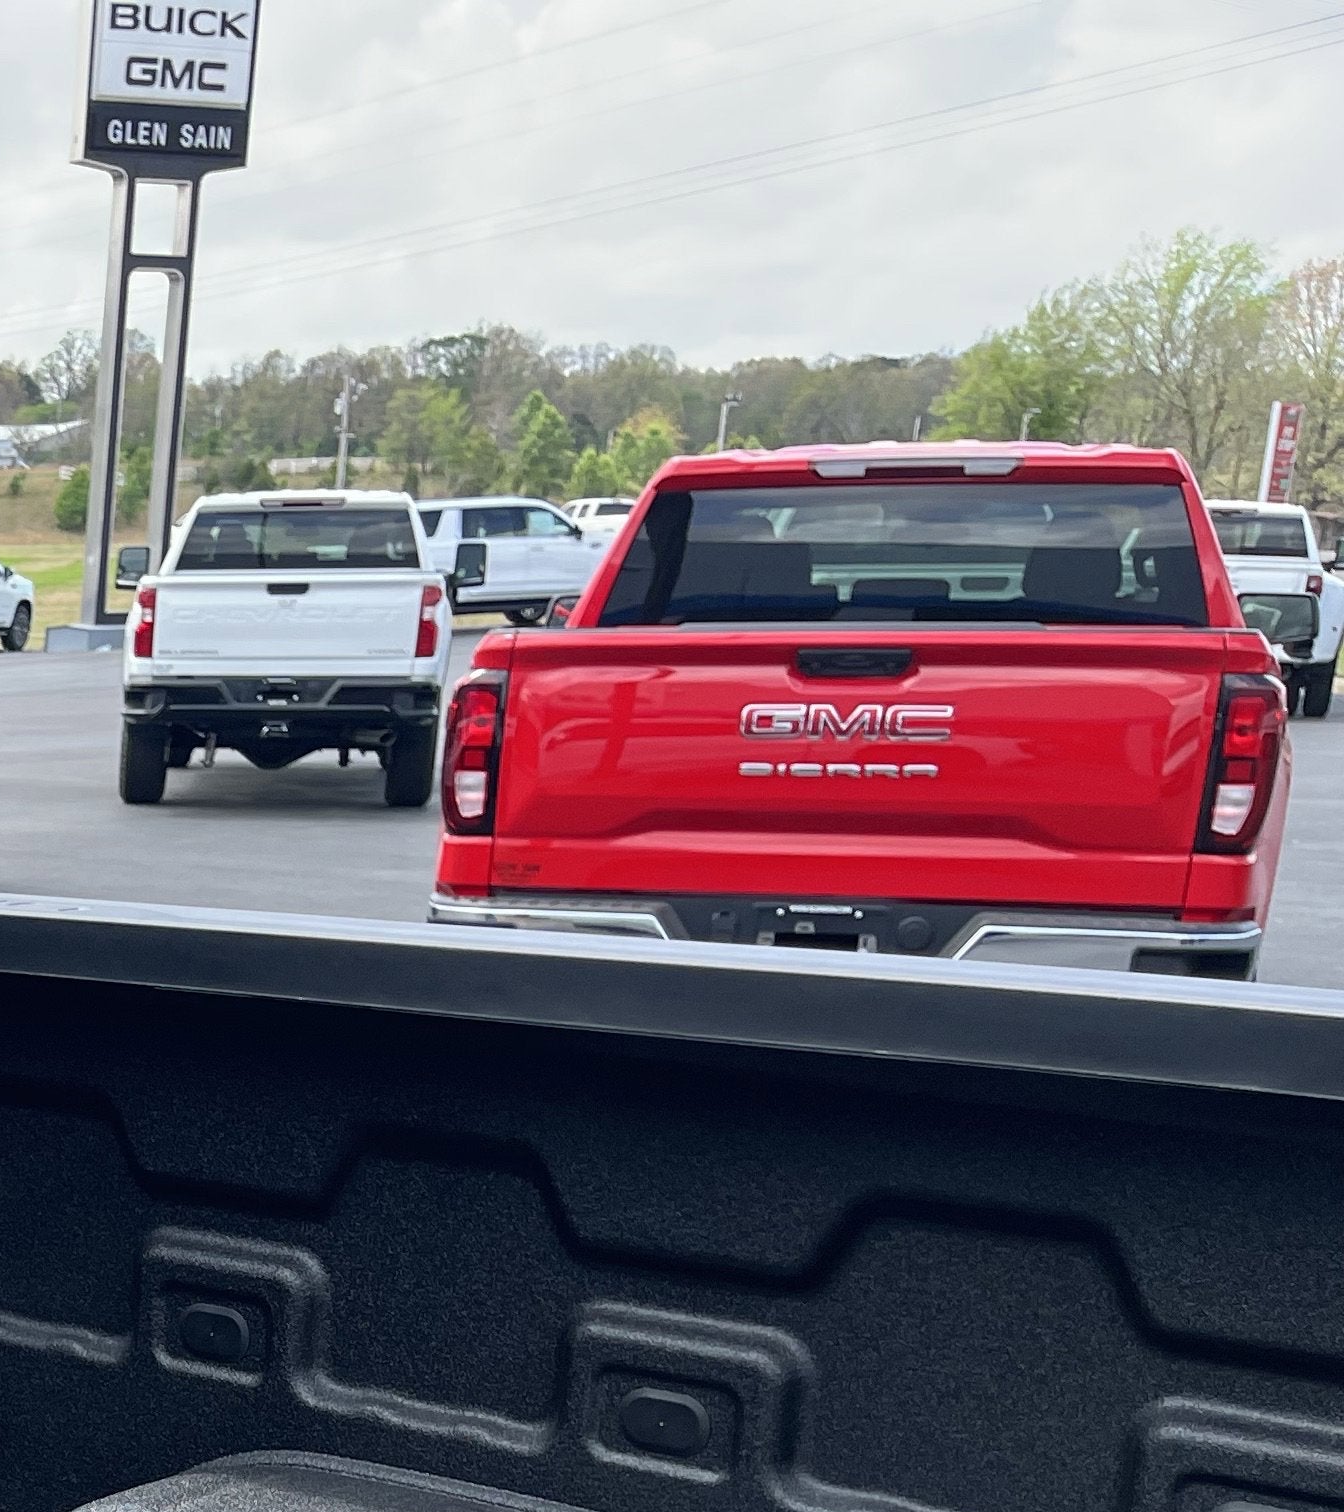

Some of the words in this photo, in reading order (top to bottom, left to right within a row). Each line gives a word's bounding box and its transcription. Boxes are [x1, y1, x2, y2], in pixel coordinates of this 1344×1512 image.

[111, 3, 248, 39] BUICK
[126, 56, 227, 92] GMC
[107, 118, 167, 147] GLEN
[179, 123, 232, 150] SAIN
[740, 703, 954, 741] GMC
[738, 762, 938, 778] SIERRA
